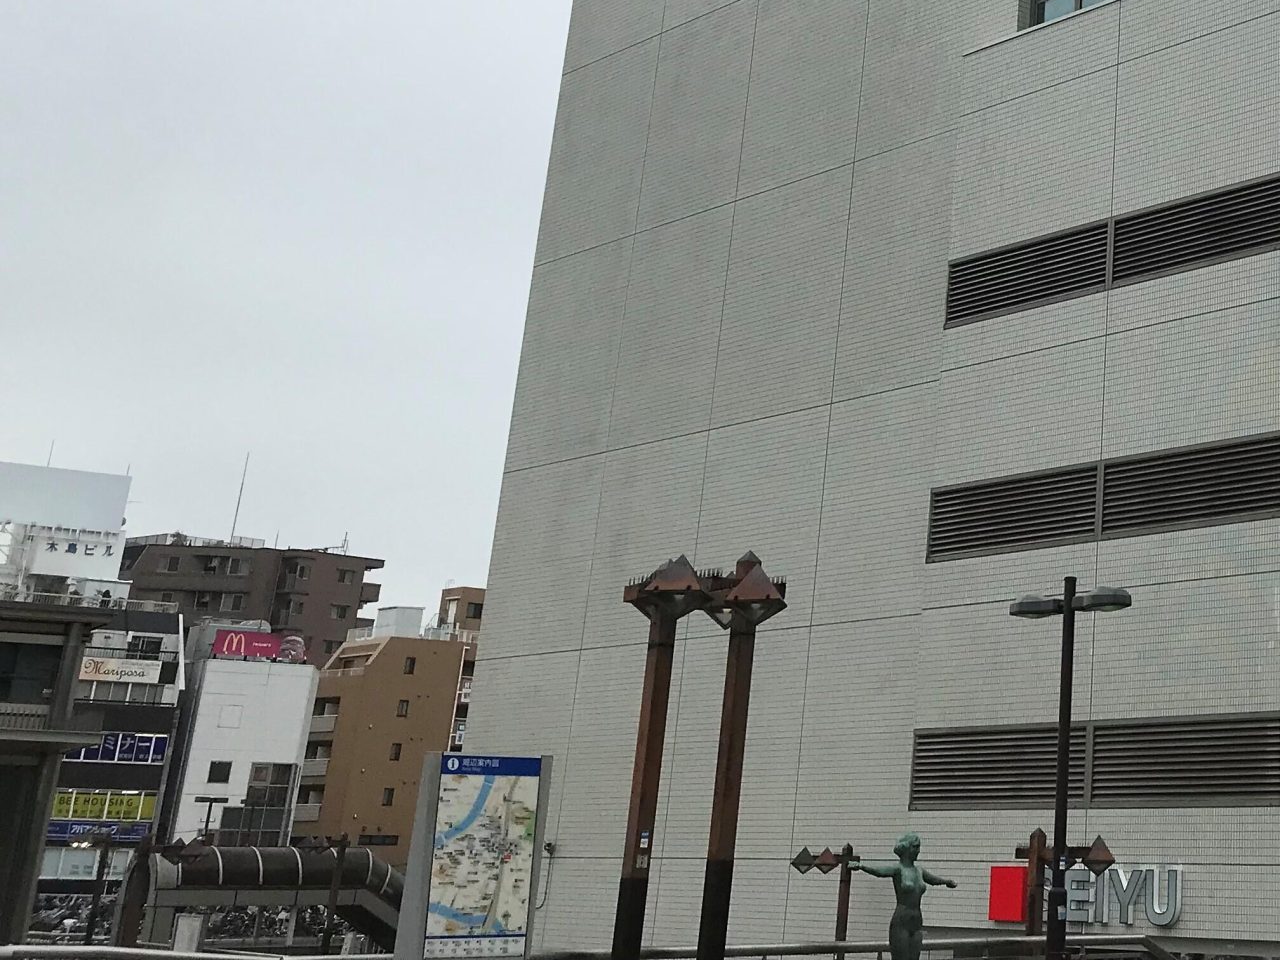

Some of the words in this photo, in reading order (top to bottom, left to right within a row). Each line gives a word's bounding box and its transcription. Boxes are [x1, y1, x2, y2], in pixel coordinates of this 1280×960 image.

[84, 659, 146, 680] Mariposa
[89, 736, 150, 751] ミナー
[58, 796, 79, 806] BEE
[83, 797, 134, 807] HOUSING
